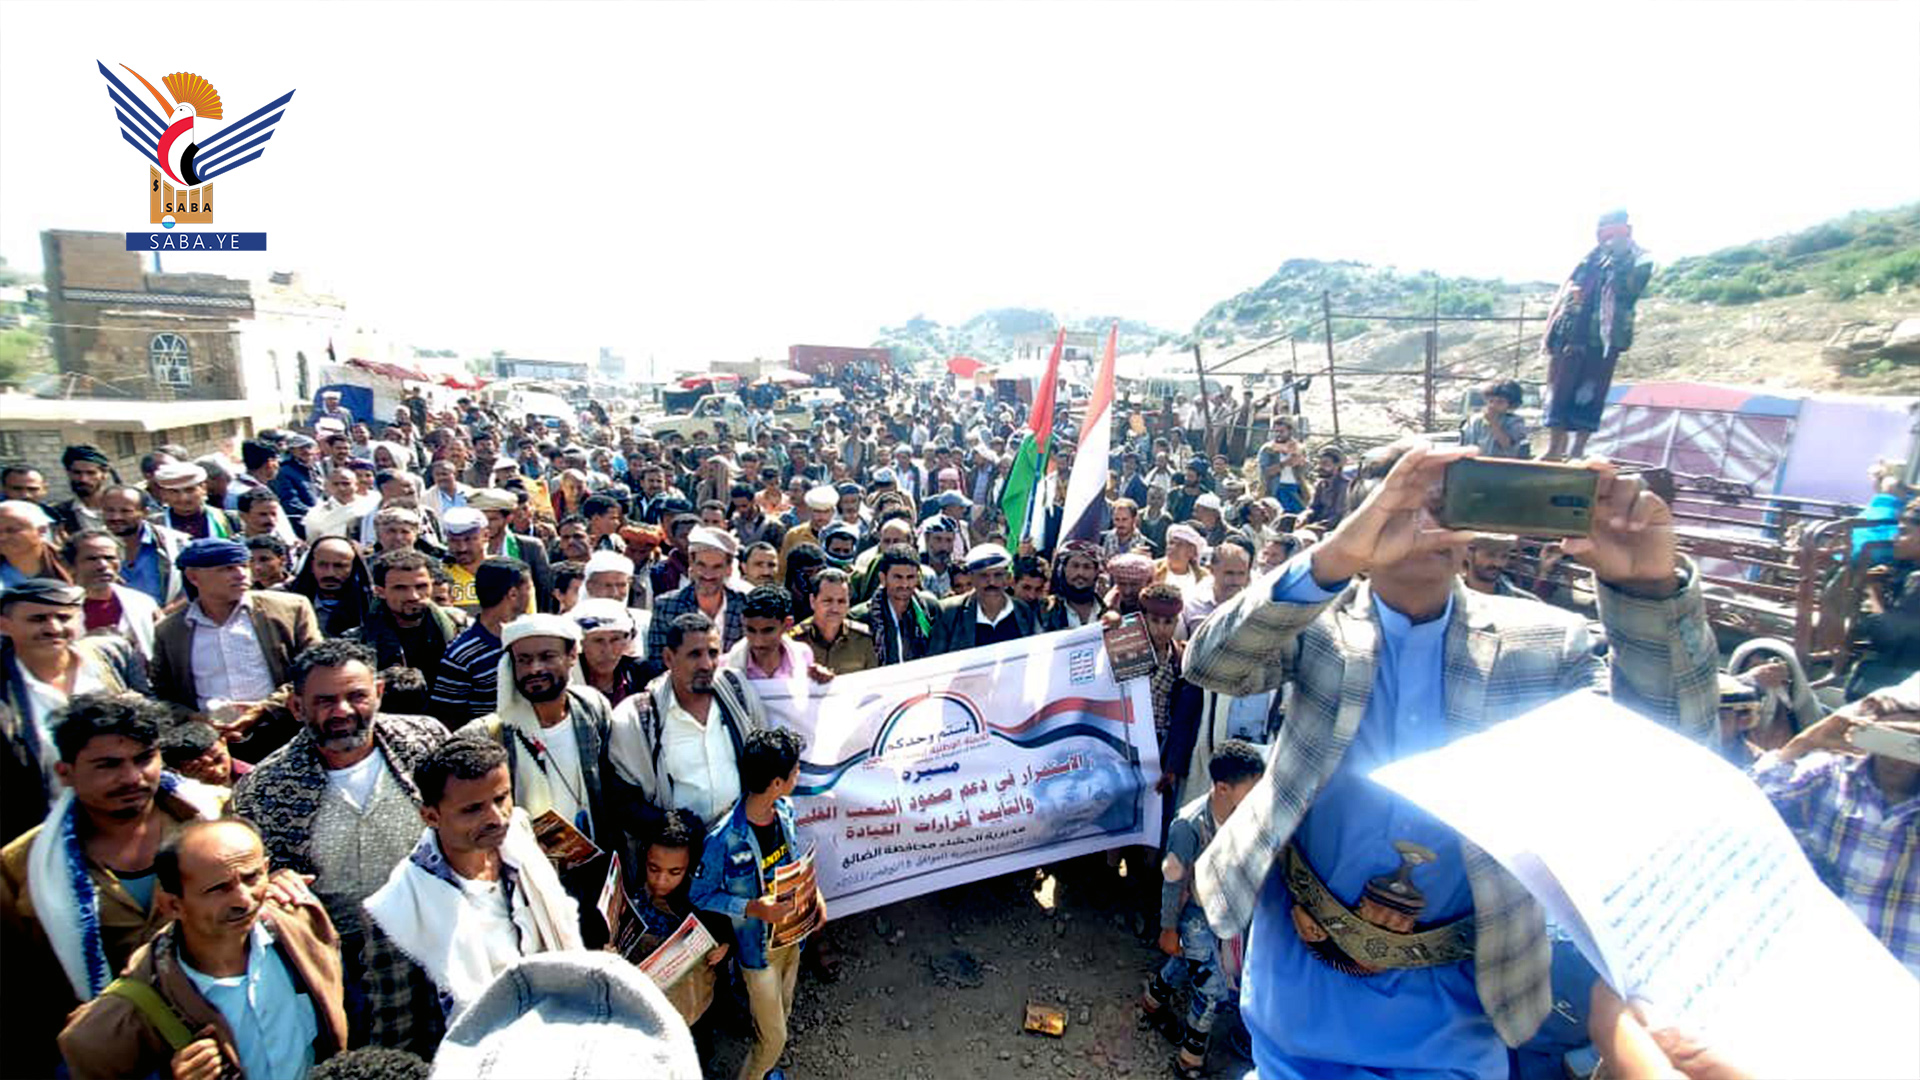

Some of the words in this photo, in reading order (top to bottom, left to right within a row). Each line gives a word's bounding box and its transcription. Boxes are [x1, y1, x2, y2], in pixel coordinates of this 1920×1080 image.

[937, 720, 970, 742] لستم
[959, 778, 988, 803] دعم
[994, 768, 1016, 796] في
[845, 796, 902, 821] الشعب
[909, 787, 953, 812] صمود
[845, 822, 900, 840] القيادة
[914, 808, 972, 833] لقرارات
[841, 845, 882, 869] الضالع
